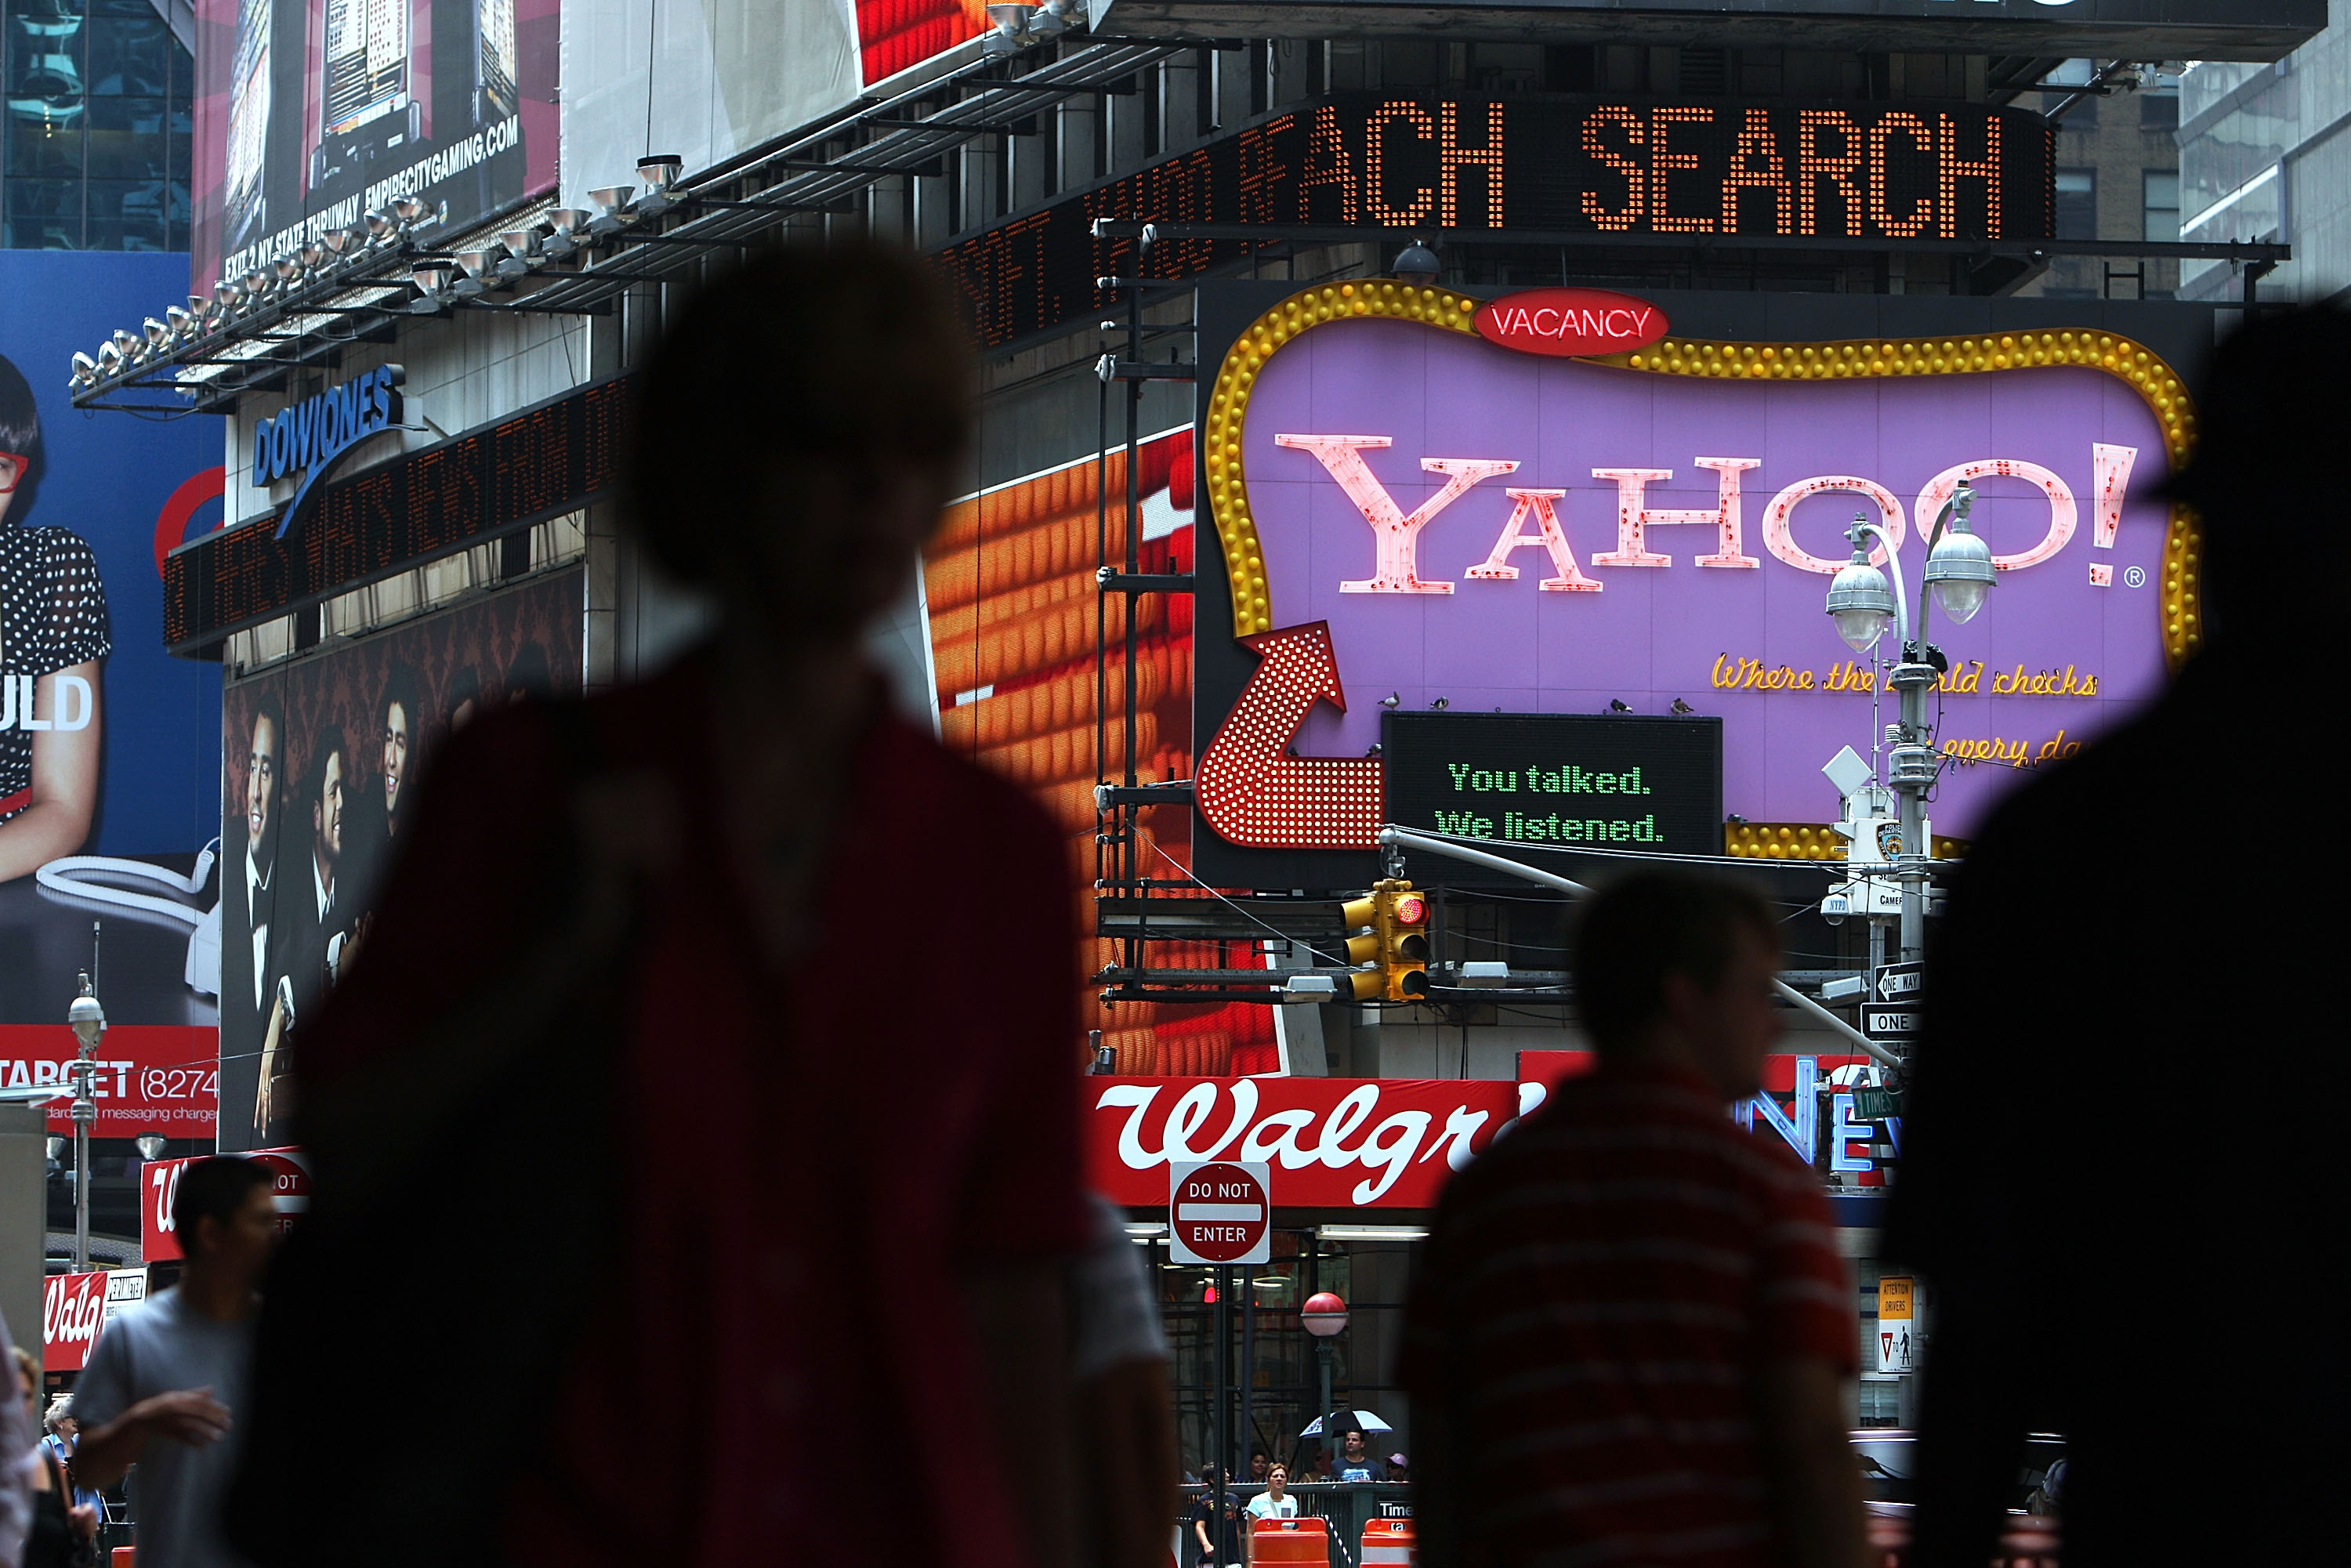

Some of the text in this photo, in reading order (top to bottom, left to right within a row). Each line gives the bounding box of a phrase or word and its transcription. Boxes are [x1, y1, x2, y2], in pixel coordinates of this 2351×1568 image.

[1238, 100, 1505, 255] REACH
[1581, 103, 2001, 240] SEARCH
[226, 114, 519, 284] EXIT 2 NY STATE THRUWAY EMPIRECITYGAMING.COM
[1491, 304, 1652, 340] VACANCY
[407, 436, 480, 557] NEWS
[496, 400, 569, 525] FROM
[1274, 433, 2139, 595] YAHOO!
[1712, 652, 2099, 697] Where the rld checks
[1936, 730, 2094, 768] every da
[1448, 763, 1651, 795] You talked.
[1435, 810, 1665, 842] We listened.
[1878, 828, 1902, 838] DEPARTM
[1829, 900, 1846, 911] NYPD
[1882, 974, 1918, 992] ONE WAY
[1878, 1015, 1910, 1030] ONE
[102, 1106, 170, 1122] messaging
[173, 1106, 218, 1122] charge
[1864, 1089, 1893, 1114] TIMES
[1096, 1078, 1546, 1206] Walgr
[273, 1174, 299, 1190] OT
[1189, 1182, 1252, 1199] DO NOT
[1194, 1227, 1247, 1243] ENTER
[107, 1275, 143, 1302] PERIMETER
[1883, 1283, 1909, 1295] ATTENTION
[1885, 1300, 1906, 1312] DRIVERS
[44, 1276, 104, 1368] Walg
[1893, 1342, 1899, 1353] TO
[1379, 1501, 1415, 1517] Time
